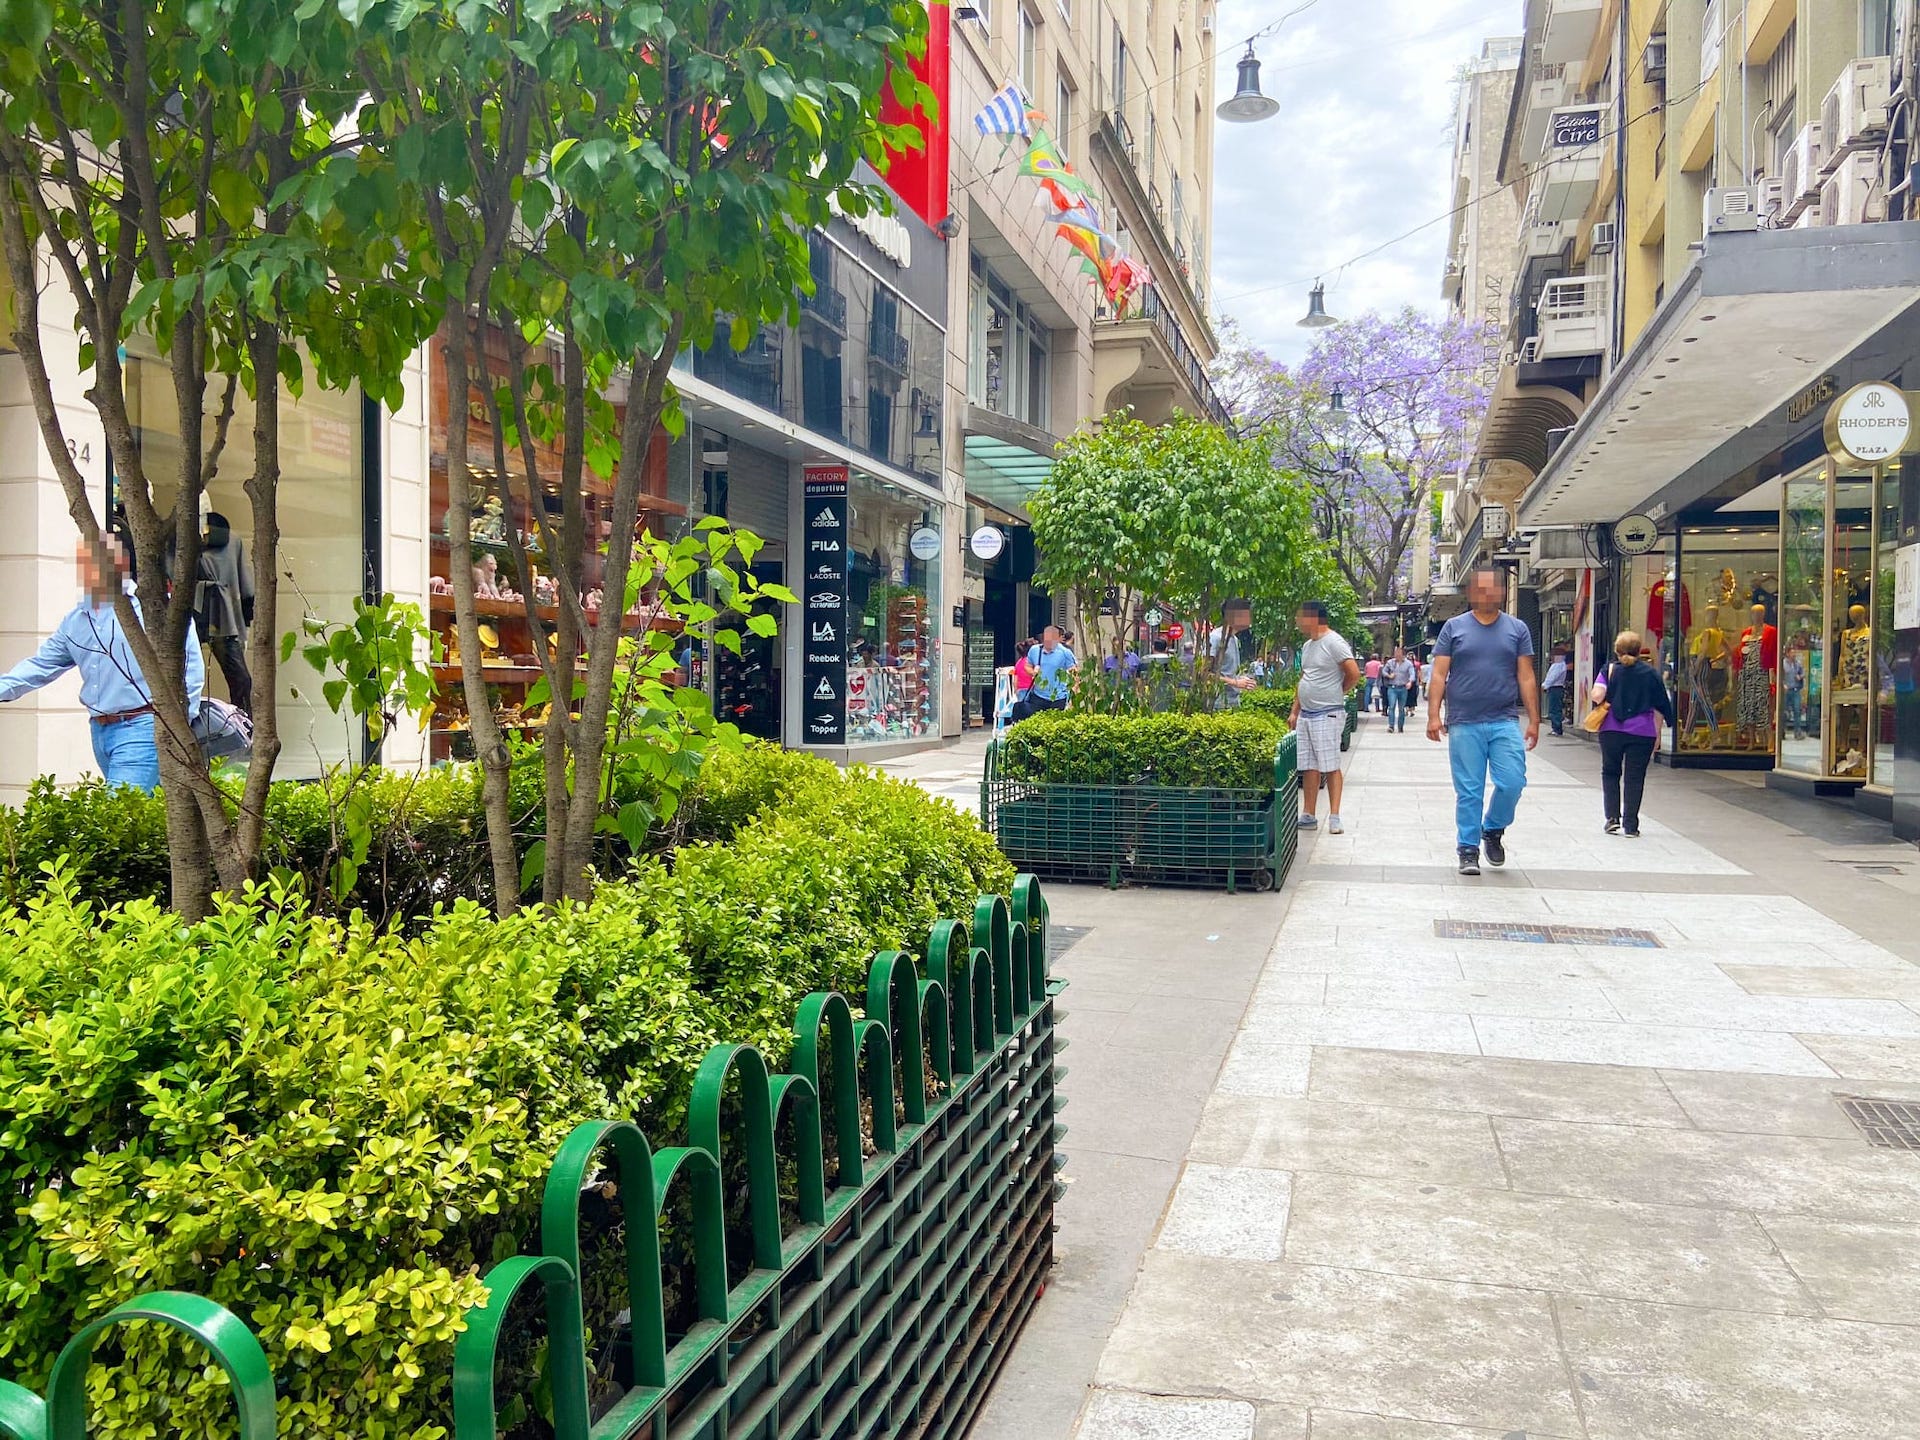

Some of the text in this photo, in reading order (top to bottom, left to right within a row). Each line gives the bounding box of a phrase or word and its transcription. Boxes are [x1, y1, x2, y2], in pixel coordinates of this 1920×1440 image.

[1839, 418, 1908, 428] RHODER'S
[806, 473, 845, 481] FACTORY
[806, 484, 845, 492] deportivo
[811, 541, 840, 551] FILA
[812, 621, 836, 636] LA
[809, 654, 840, 662] Reebok
[810, 725, 838, 734] Topper
